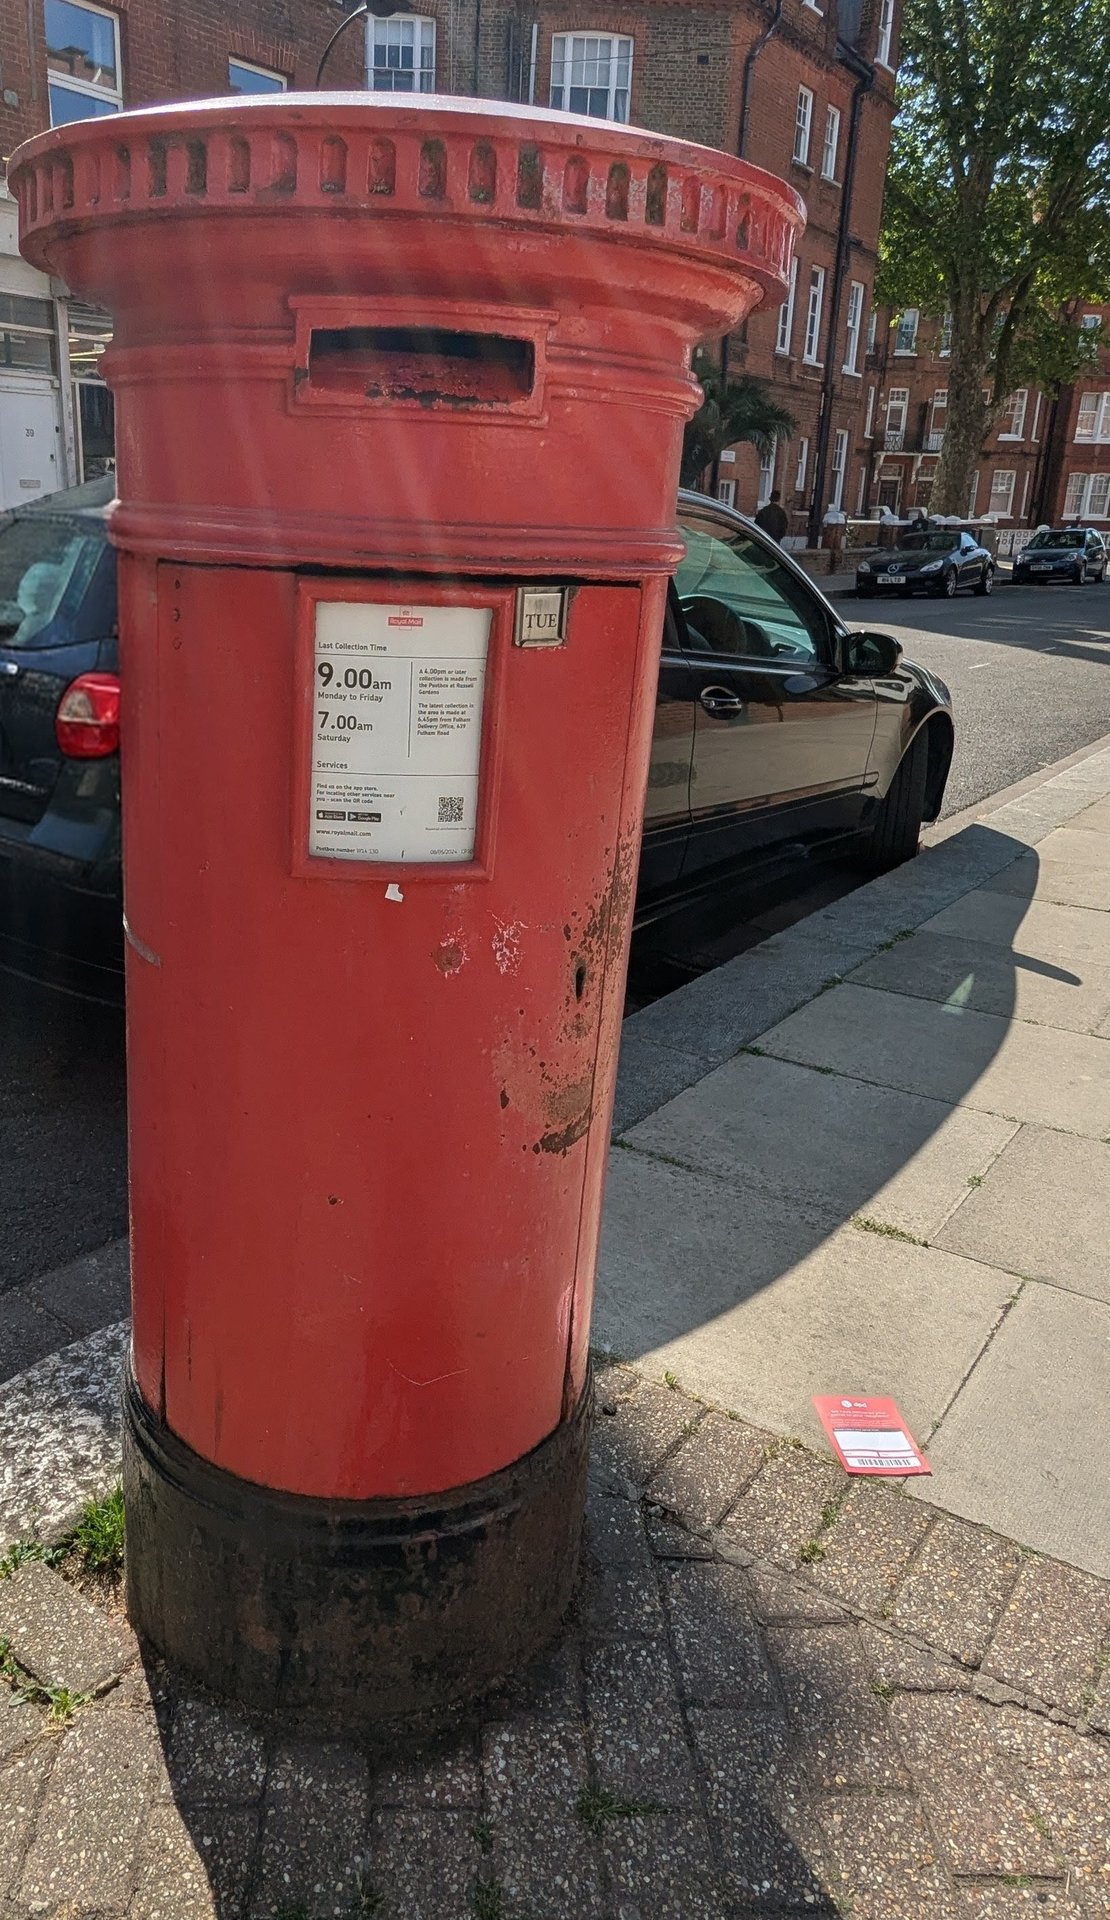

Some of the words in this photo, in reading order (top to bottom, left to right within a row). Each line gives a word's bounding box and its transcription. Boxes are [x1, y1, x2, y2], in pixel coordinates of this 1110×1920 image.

[25, 428, 35, 438] 39
[389, 617, 407, 626] Royal
[407, 617, 422, 626] Mail
[525, 613, 557, 629] TUE
[335, 642, 368, 651] Collection
[370, 643, 387, 651] Time
[317, 661, 392, 690] 9.00am
[317, 691, 348, 701] Monday
[359, 693, 383, 702] Friday
[317, 710, 373, 731] 7.00am
[317, 733, 351, 743] Saturday
[316, 760, 348, 769] Services
[316, 829, 372, 837] www.royalmail.com
